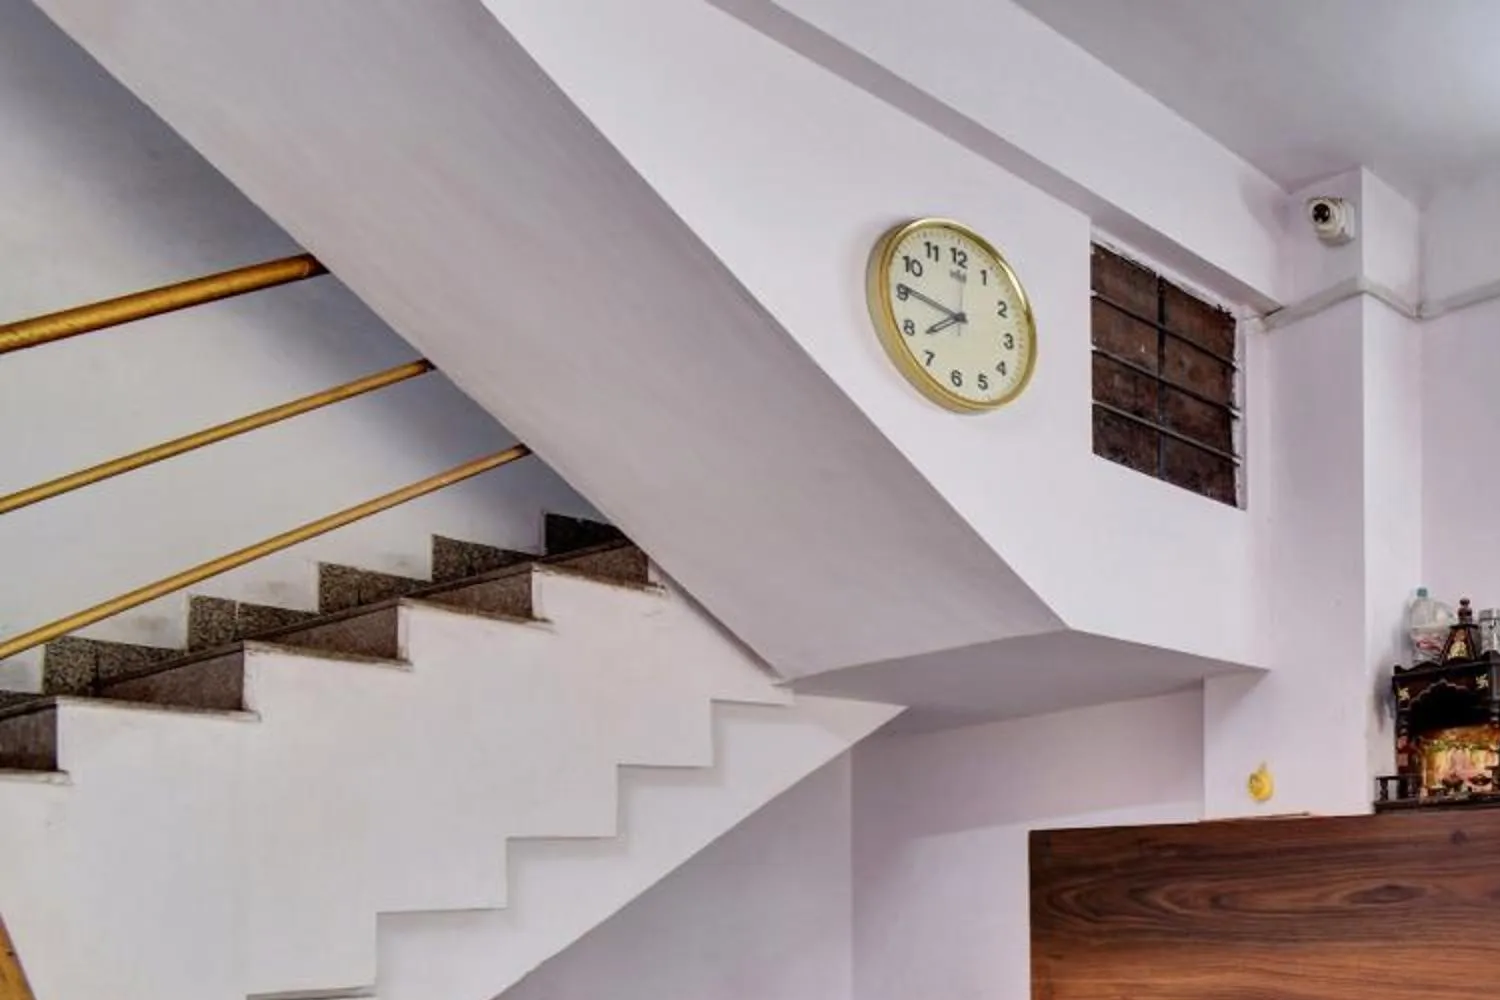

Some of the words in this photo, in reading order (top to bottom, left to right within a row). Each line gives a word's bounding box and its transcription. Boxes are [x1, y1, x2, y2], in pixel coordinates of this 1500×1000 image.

[924, 241, 939, 262] 11
[950, 247, 968, 269] 12
[903, 255, 923, 277] 10
[980, 269, 988, 286] 1
[997, 300, 1008, 318] 2
[903, 319, 915, 336] 8
[1003, 333, 1014, 350] 3
[924, 350, 935, 366] 7
[996, 361, 1007, 376] 4
[951, 370, 963, 387] 6
[978, 373, 988, 390] 5
